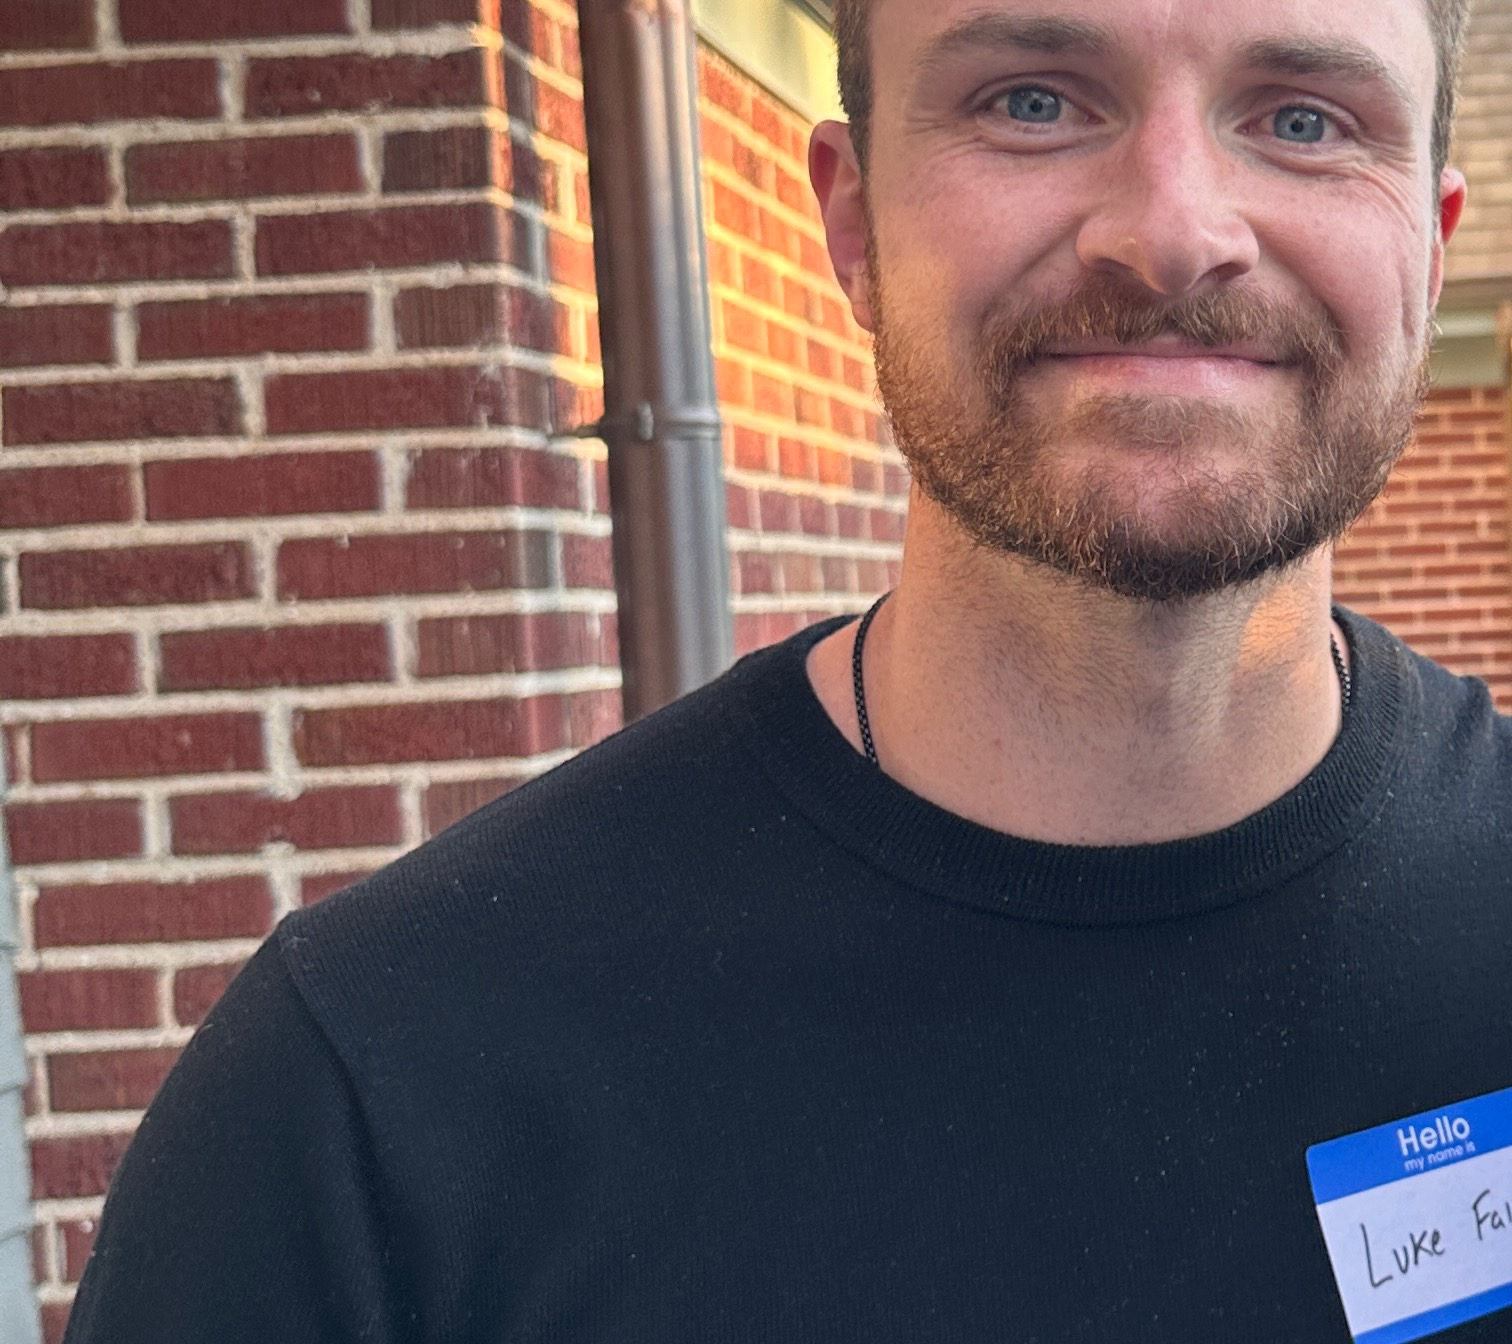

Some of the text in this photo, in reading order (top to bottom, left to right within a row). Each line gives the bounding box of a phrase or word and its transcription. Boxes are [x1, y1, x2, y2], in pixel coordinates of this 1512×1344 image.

[1397, 1115, 1470, 1156] Hello
[1404, 1140, 1476, 1170] my name is
[1360, 1222, 1446, 1288] Luke
